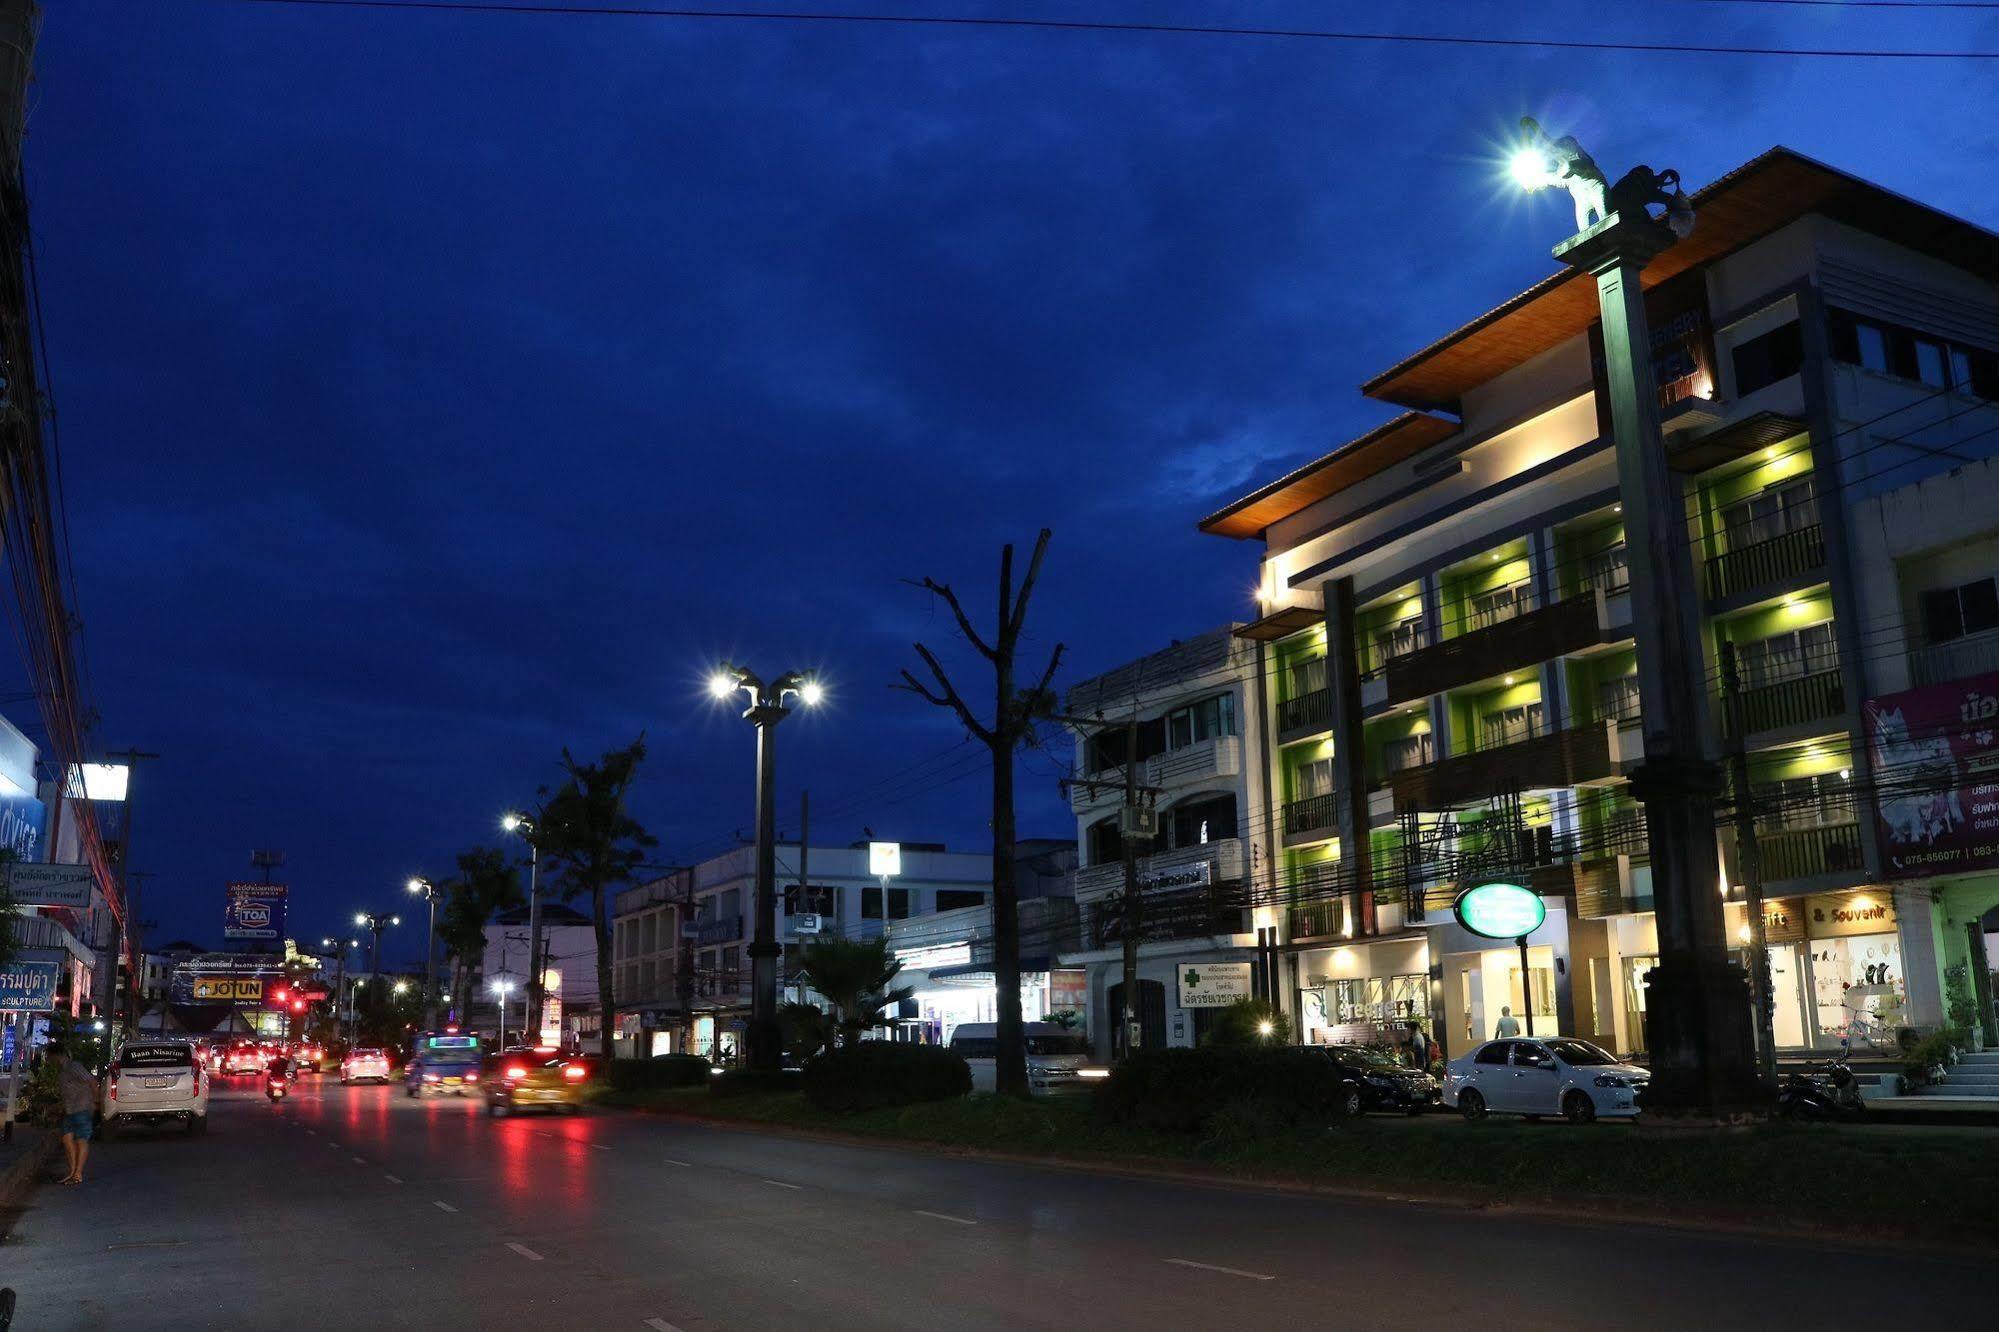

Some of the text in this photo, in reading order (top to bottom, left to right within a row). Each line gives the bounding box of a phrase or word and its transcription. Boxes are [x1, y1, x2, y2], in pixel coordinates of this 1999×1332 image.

[242, 910, 267, 920] TOA
[1831, 904, 1885, 923] Souvenir
[212, 982, 259, 996] JOTUN
[2, 997, 42, 1006] SCULPTURE
[1376, 1022, 1408, 1032] HOTEL
